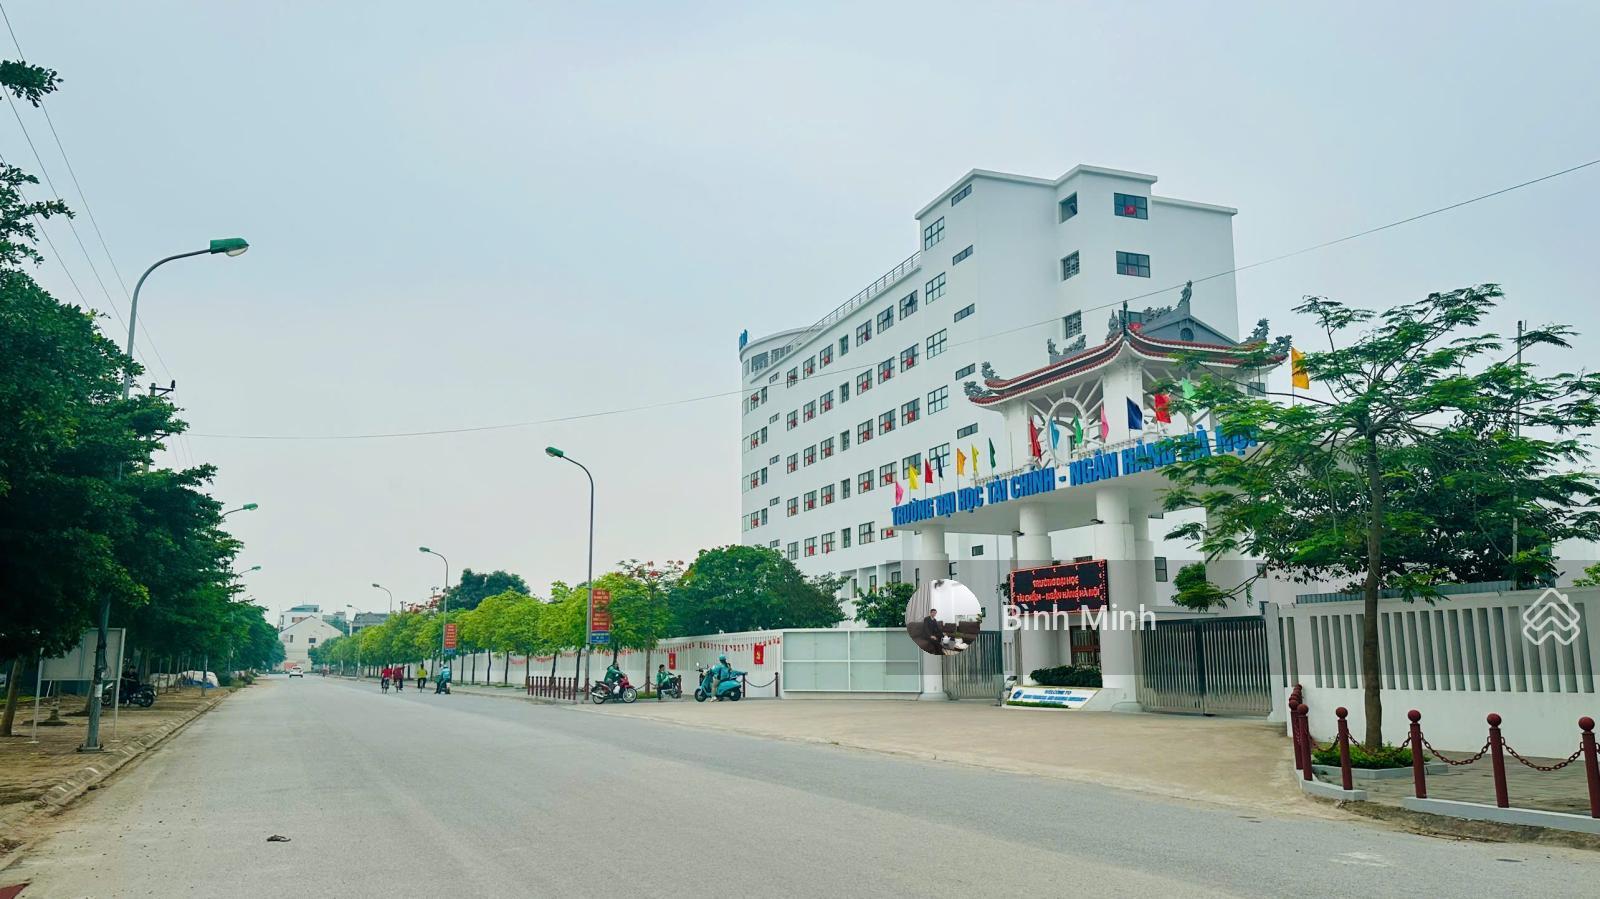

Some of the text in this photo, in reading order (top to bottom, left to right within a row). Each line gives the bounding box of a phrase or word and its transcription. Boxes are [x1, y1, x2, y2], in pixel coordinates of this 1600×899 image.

[891, 497, 934, 526] TRƯỜNG
[936, 491, 957, 518] ĐẠI
[957, 486, 984, 513] HỌC
[986, 475, 1008, 504] TÀI
[1010, 467, 1056, 499] CHÍNH
[1069, 448, 1119, 486] NGÂN
